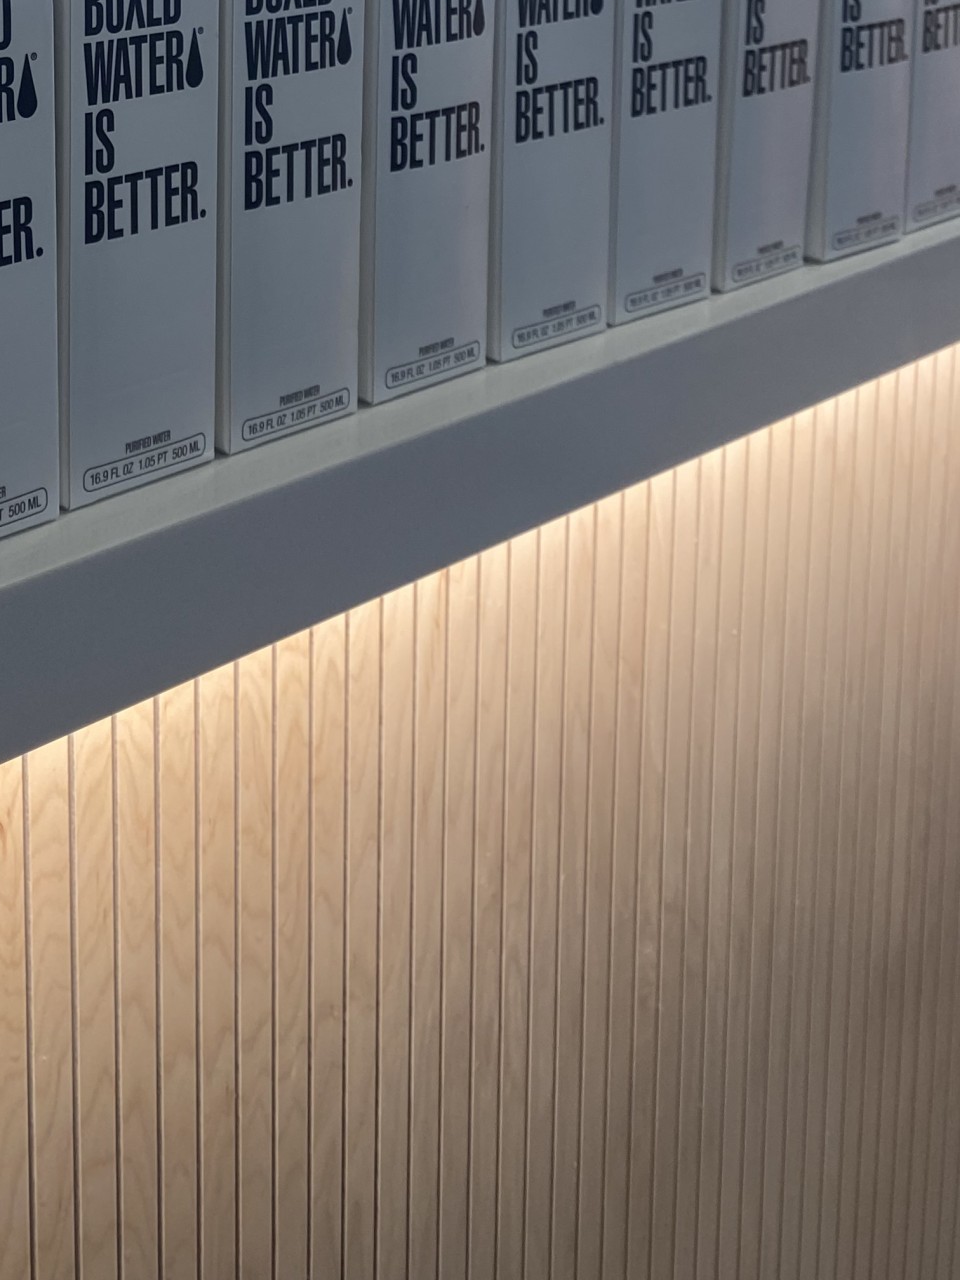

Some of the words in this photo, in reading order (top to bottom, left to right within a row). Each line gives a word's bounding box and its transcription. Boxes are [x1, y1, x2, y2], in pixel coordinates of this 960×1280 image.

[83, 30, 184, 106] WATER
[244, 10, 335, 81] WATER
[516, 30, 538, 86] IS
[632, 11, 653, 63] IS
[742, 38, 810, 97] BETTER.
[840, 18, 908, 73] BETTER.
[391, 53, 417, 111] IS
[515, 76, 604, 144] BETTER.
[631, 55, 712, 117] BETTER.
[84, 109, 115, 176] IS
[244, 83, 273, 146] IS
[390, 101, 484, 171] BETTER.
[84, 161, 206, 242] BETTER.
[244, 133, 353, 211] BETTER.
[111, 467, 120, 480] FL
[123, 462, 134, 475] OZ
[157, 451, 168, 465] PT
[172, 445, 188, 460] 500
[189, 440, 201, 454] ML
[125, 436, 151, 454] PURIFIED
[152, 430, 171, 445] WATER
[9, 501, 26, 518] 500
[28, 495, 42, 510] ML
